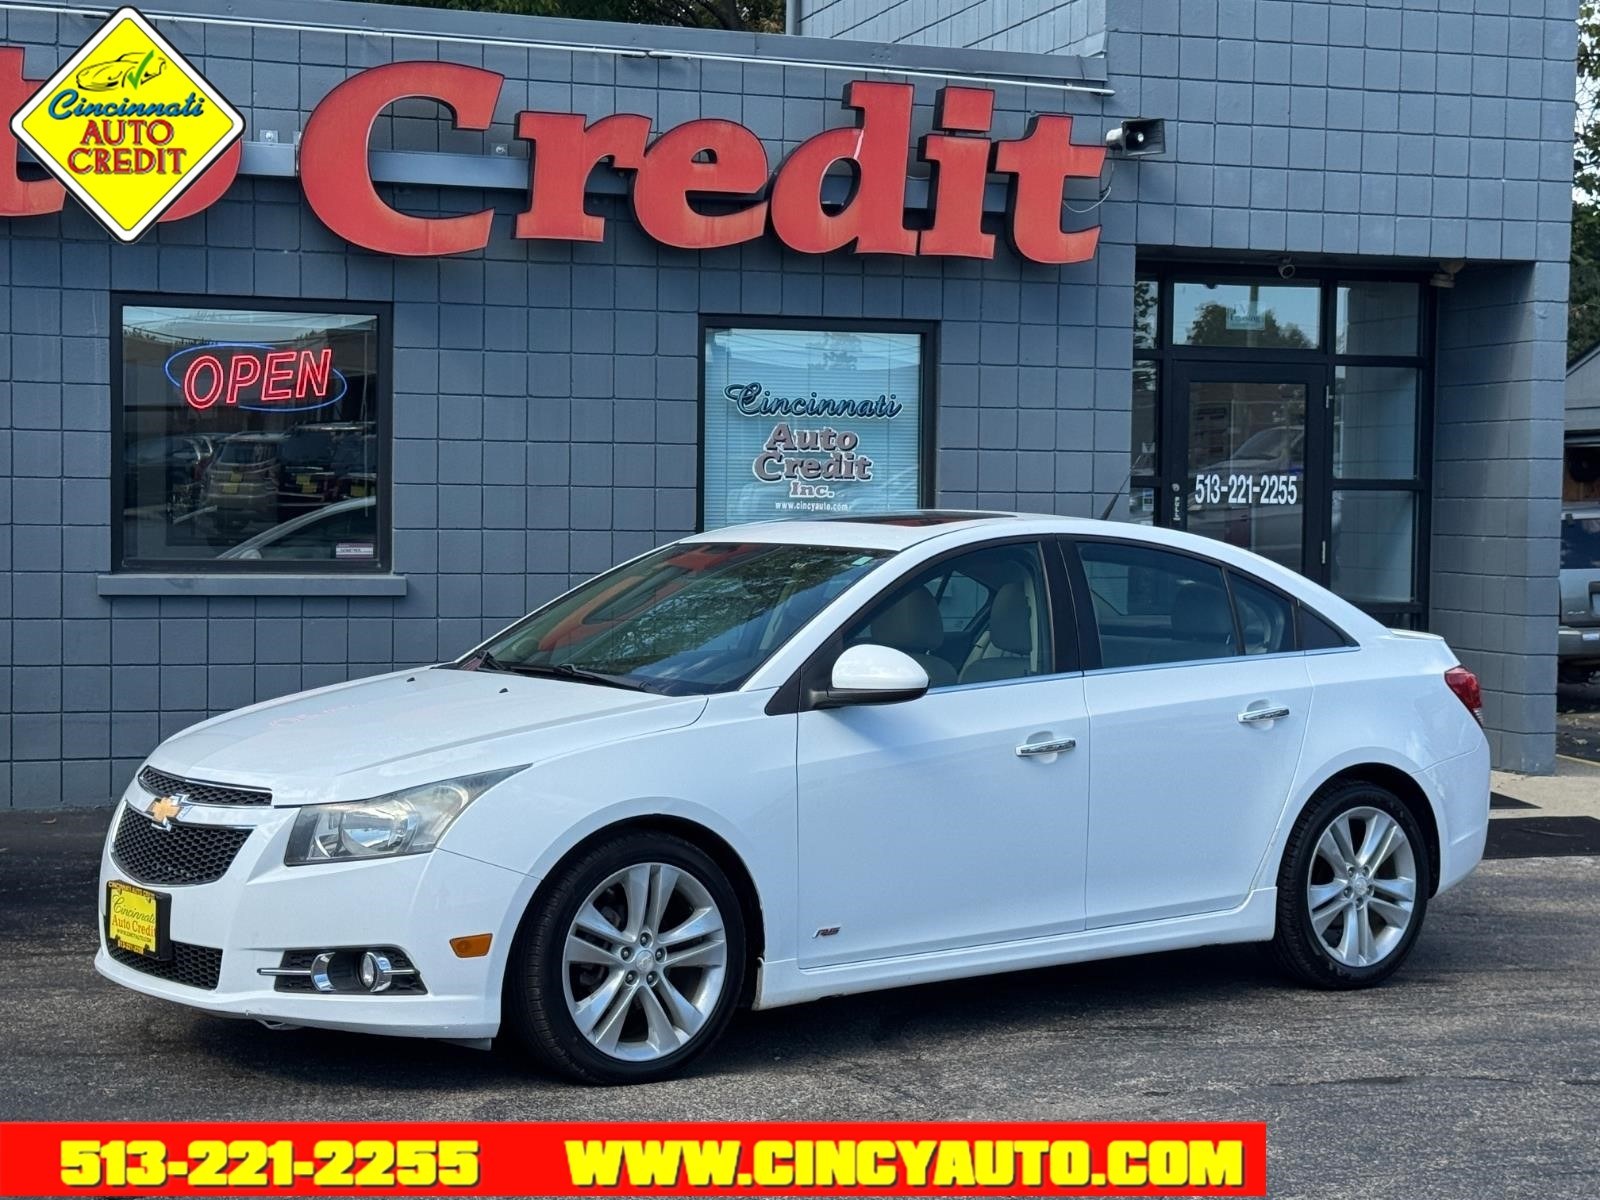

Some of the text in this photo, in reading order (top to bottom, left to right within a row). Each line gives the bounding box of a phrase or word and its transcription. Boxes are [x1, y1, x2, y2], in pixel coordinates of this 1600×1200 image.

[299, 61, 1107, 264] Credit
[184, 349, 332, 410] OPEN
[724, 382, 903, 418] Cincinnati
[765, 422, 859, 453] Auto
[753, 450, 873, 482] Credit
[789, 480, 835, 498] Inc.
[1194, 474, 1298, 505] 513-221-2255
[775, 501, 849, 512] www.cincyauto.com
[112, 914, 131, 930] Auto
